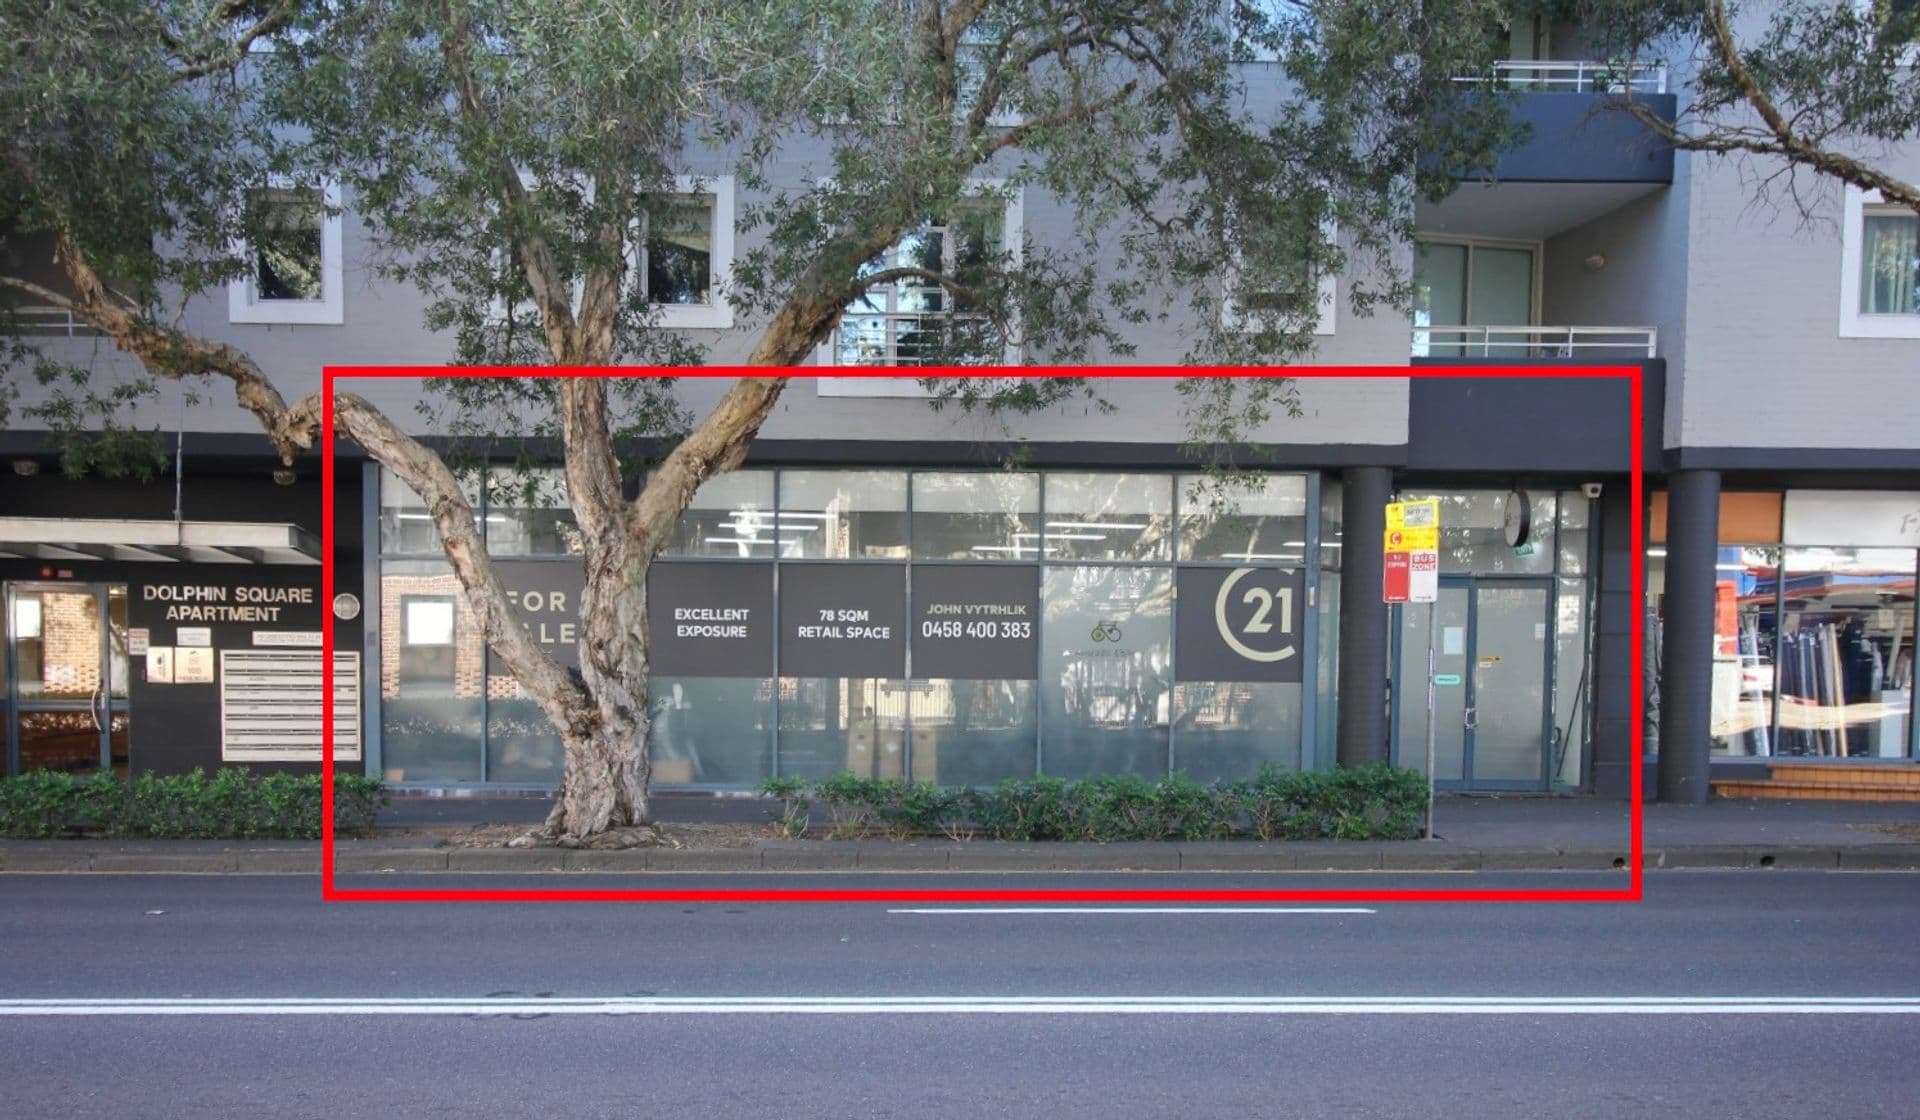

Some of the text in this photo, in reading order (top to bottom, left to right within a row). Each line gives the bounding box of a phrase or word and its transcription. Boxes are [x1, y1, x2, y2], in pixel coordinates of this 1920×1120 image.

[1413, 555, 1435, 563] BUS
[1412, 563, 1436, 571] ZONE
[143, 585, 313, 603] DOLPHIN SQUARE
[166, 605, 281, 622] APARTMENT
[674, 608, 750, 621] EXCELLENT
[819, 609, 869, 622] 78 SQM
[927, 604, 1026, 616] JOHN VYTRHLIK
[676, 625, 747, 638] EXPOSURE
[798, 626, 890, 640] RETAIL SPACE
[922, 621, 1031, 639] 0458 400 383
